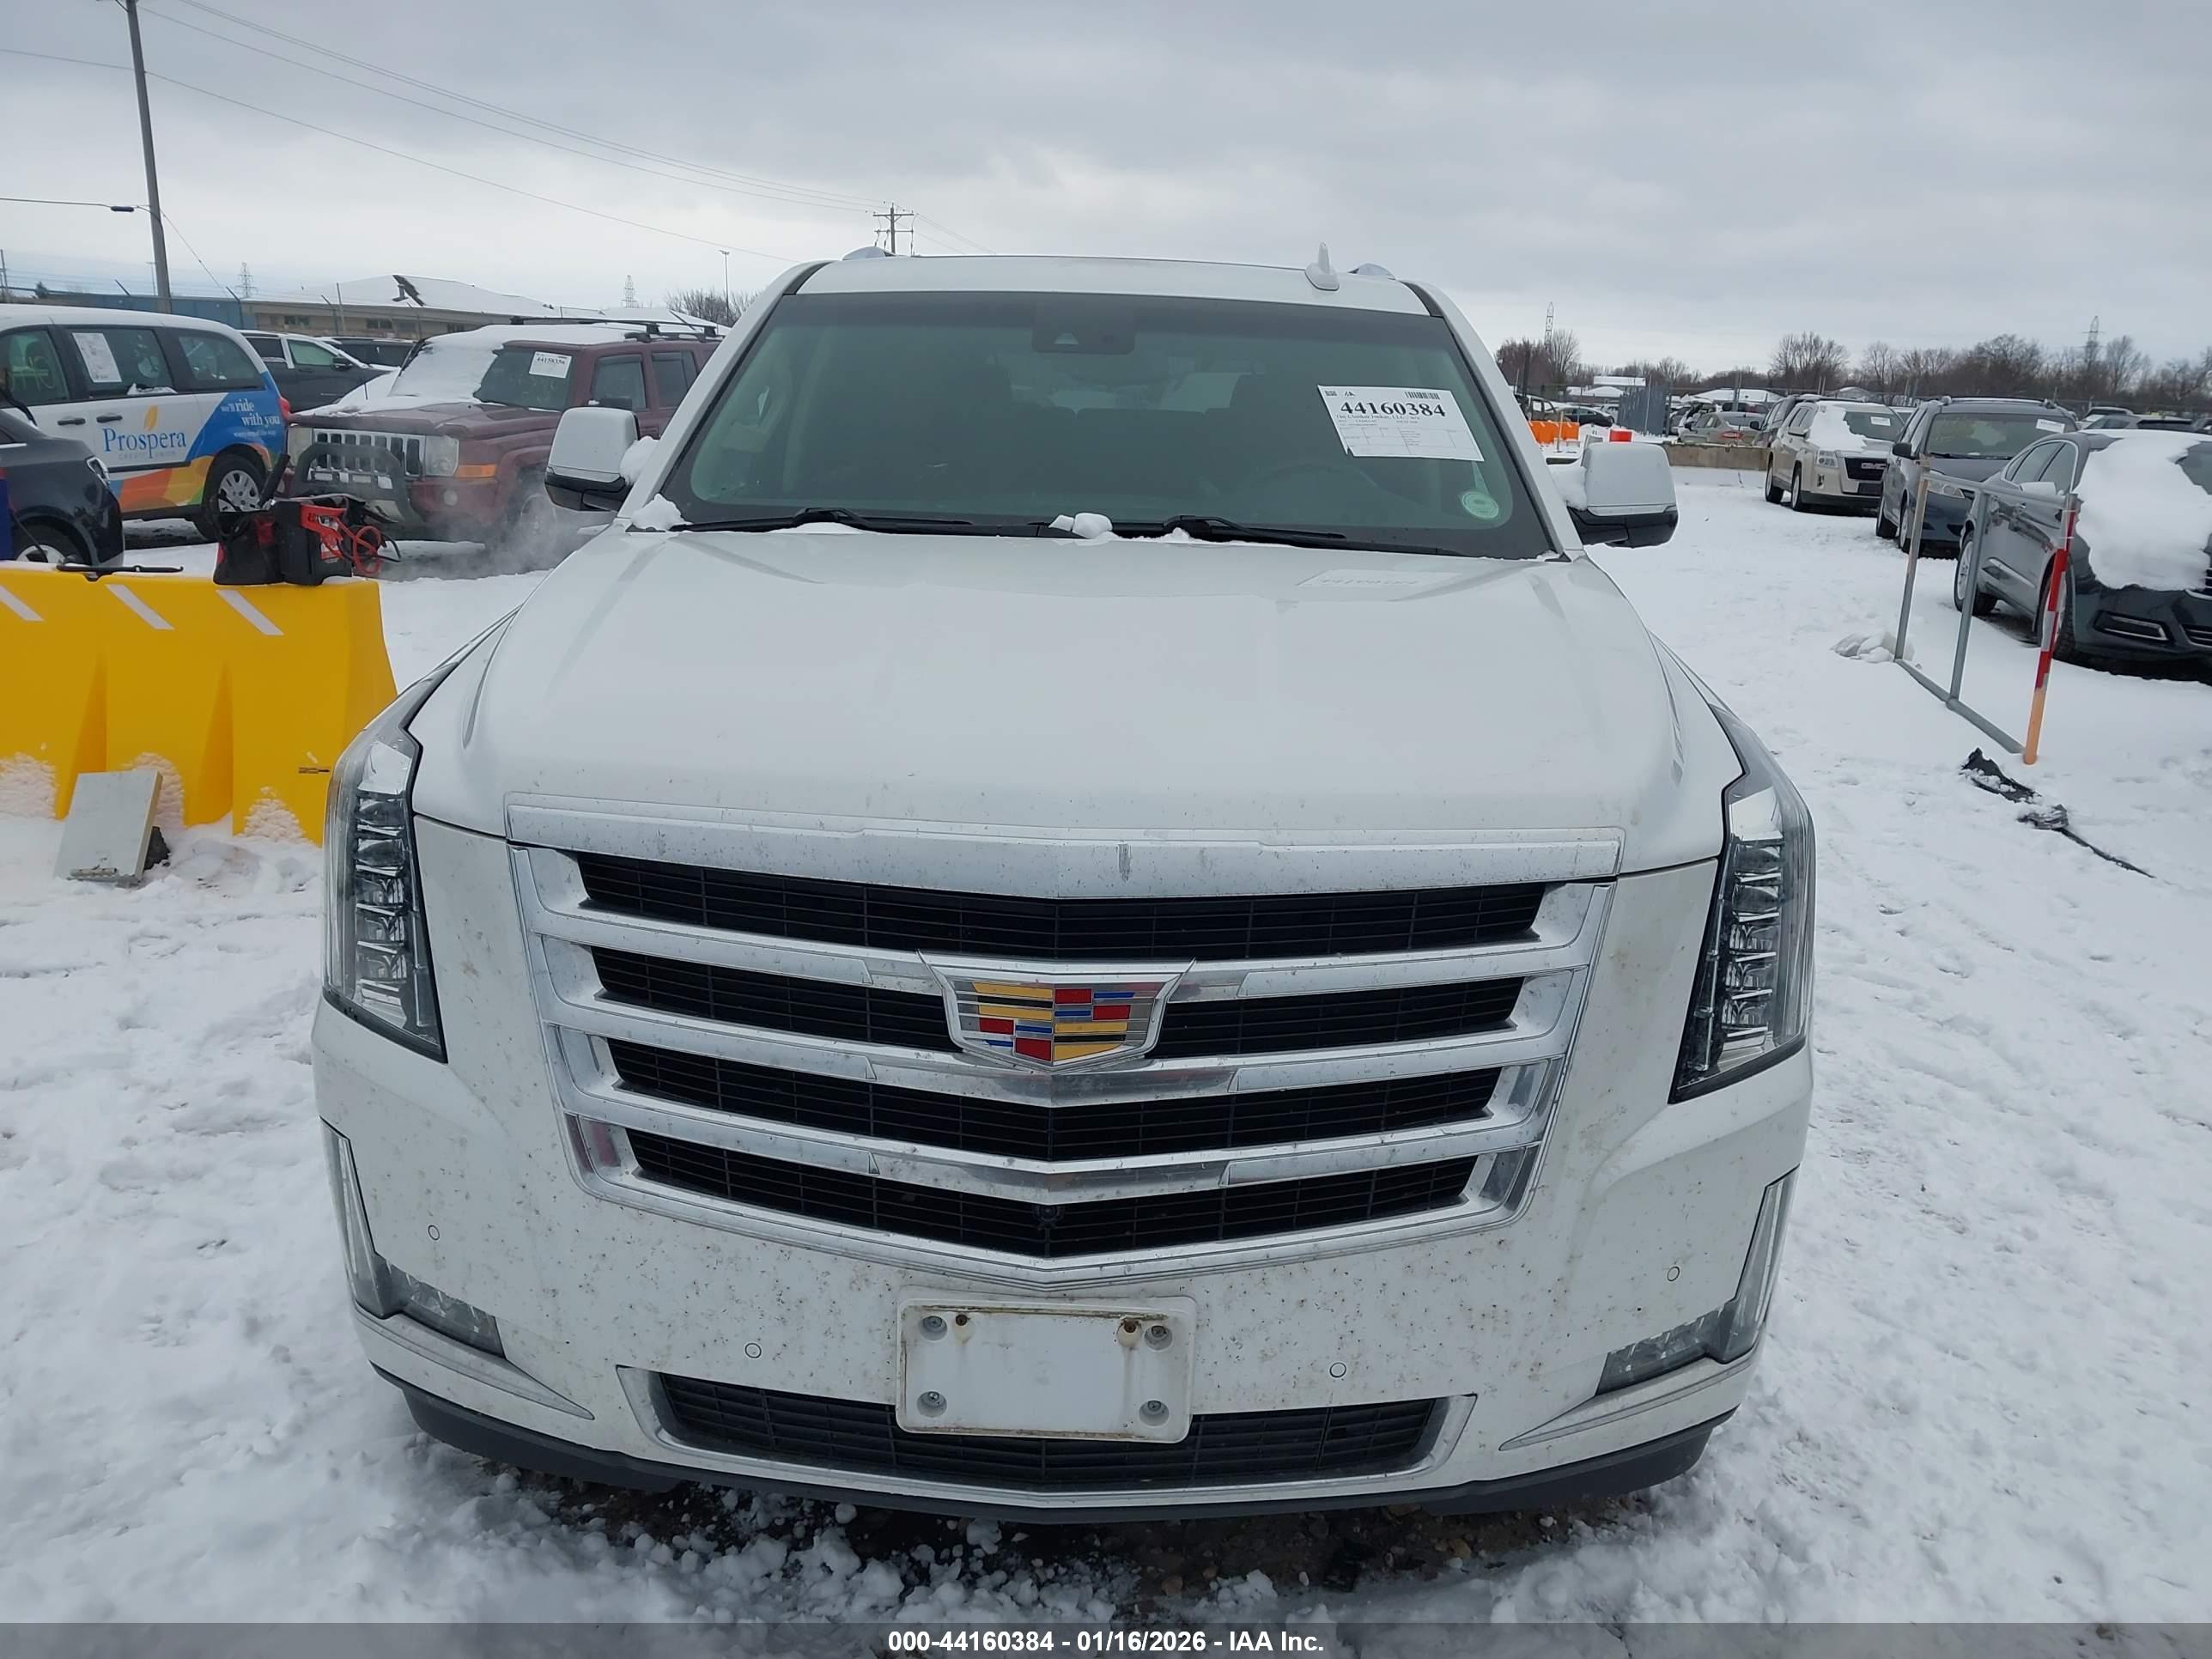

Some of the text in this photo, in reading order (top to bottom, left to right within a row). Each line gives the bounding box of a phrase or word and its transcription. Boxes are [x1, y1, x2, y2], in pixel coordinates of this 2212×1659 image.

[235, 398, 254, 412] ride
[1340, 401, 1446, 417] 44160384
[241, 412, 281, 428] with you
[102, 428, 186, 459] Prospera
